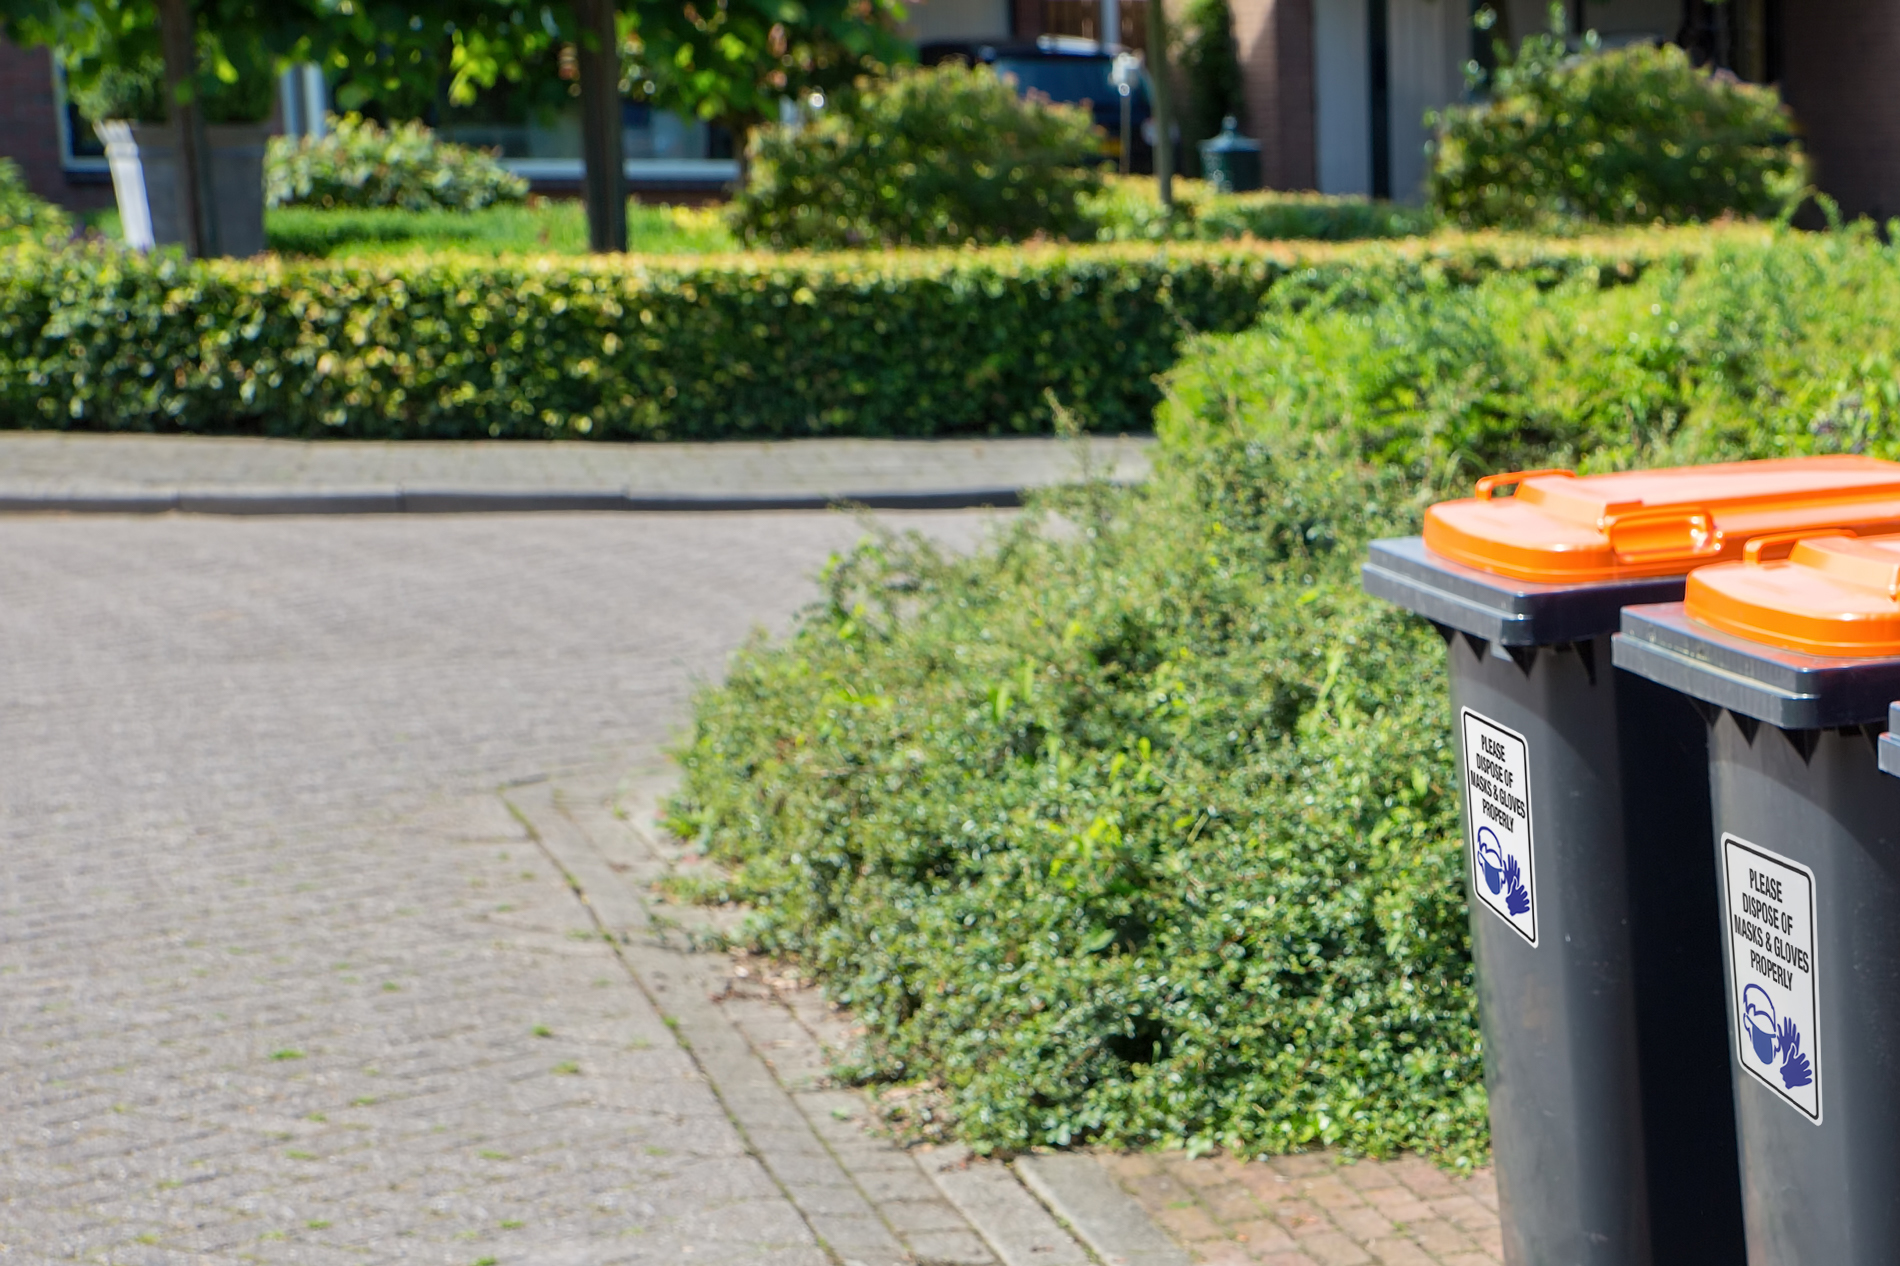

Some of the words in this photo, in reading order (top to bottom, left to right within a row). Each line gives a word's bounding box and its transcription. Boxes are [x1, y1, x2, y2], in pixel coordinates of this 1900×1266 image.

[1481, 734, 1506, 763] PLEASE
[1476, 752, 1504, 784] DISPOSE
[1504, 767, 1514, 788] OF
[1470, 770, 1492, 798] MASKS
[1493, 784, 1499, 802] &
[1499, 788, 1526, 819] GLOVES
[1482, 798, 1514, 833] PROPERLY
[1749, 868, 1783, 904] PLEASE
[1742, 892, 1780, 930] DISPOSE
[1780, 912, 1793, 936] OF
[1734, 914, 1764, 948] MASKS
[1765, 931, 1773, 954] &
[1773, 935, 1810, 974] GLOVES
[1750, 949, 1793, 991] PROPERLY
